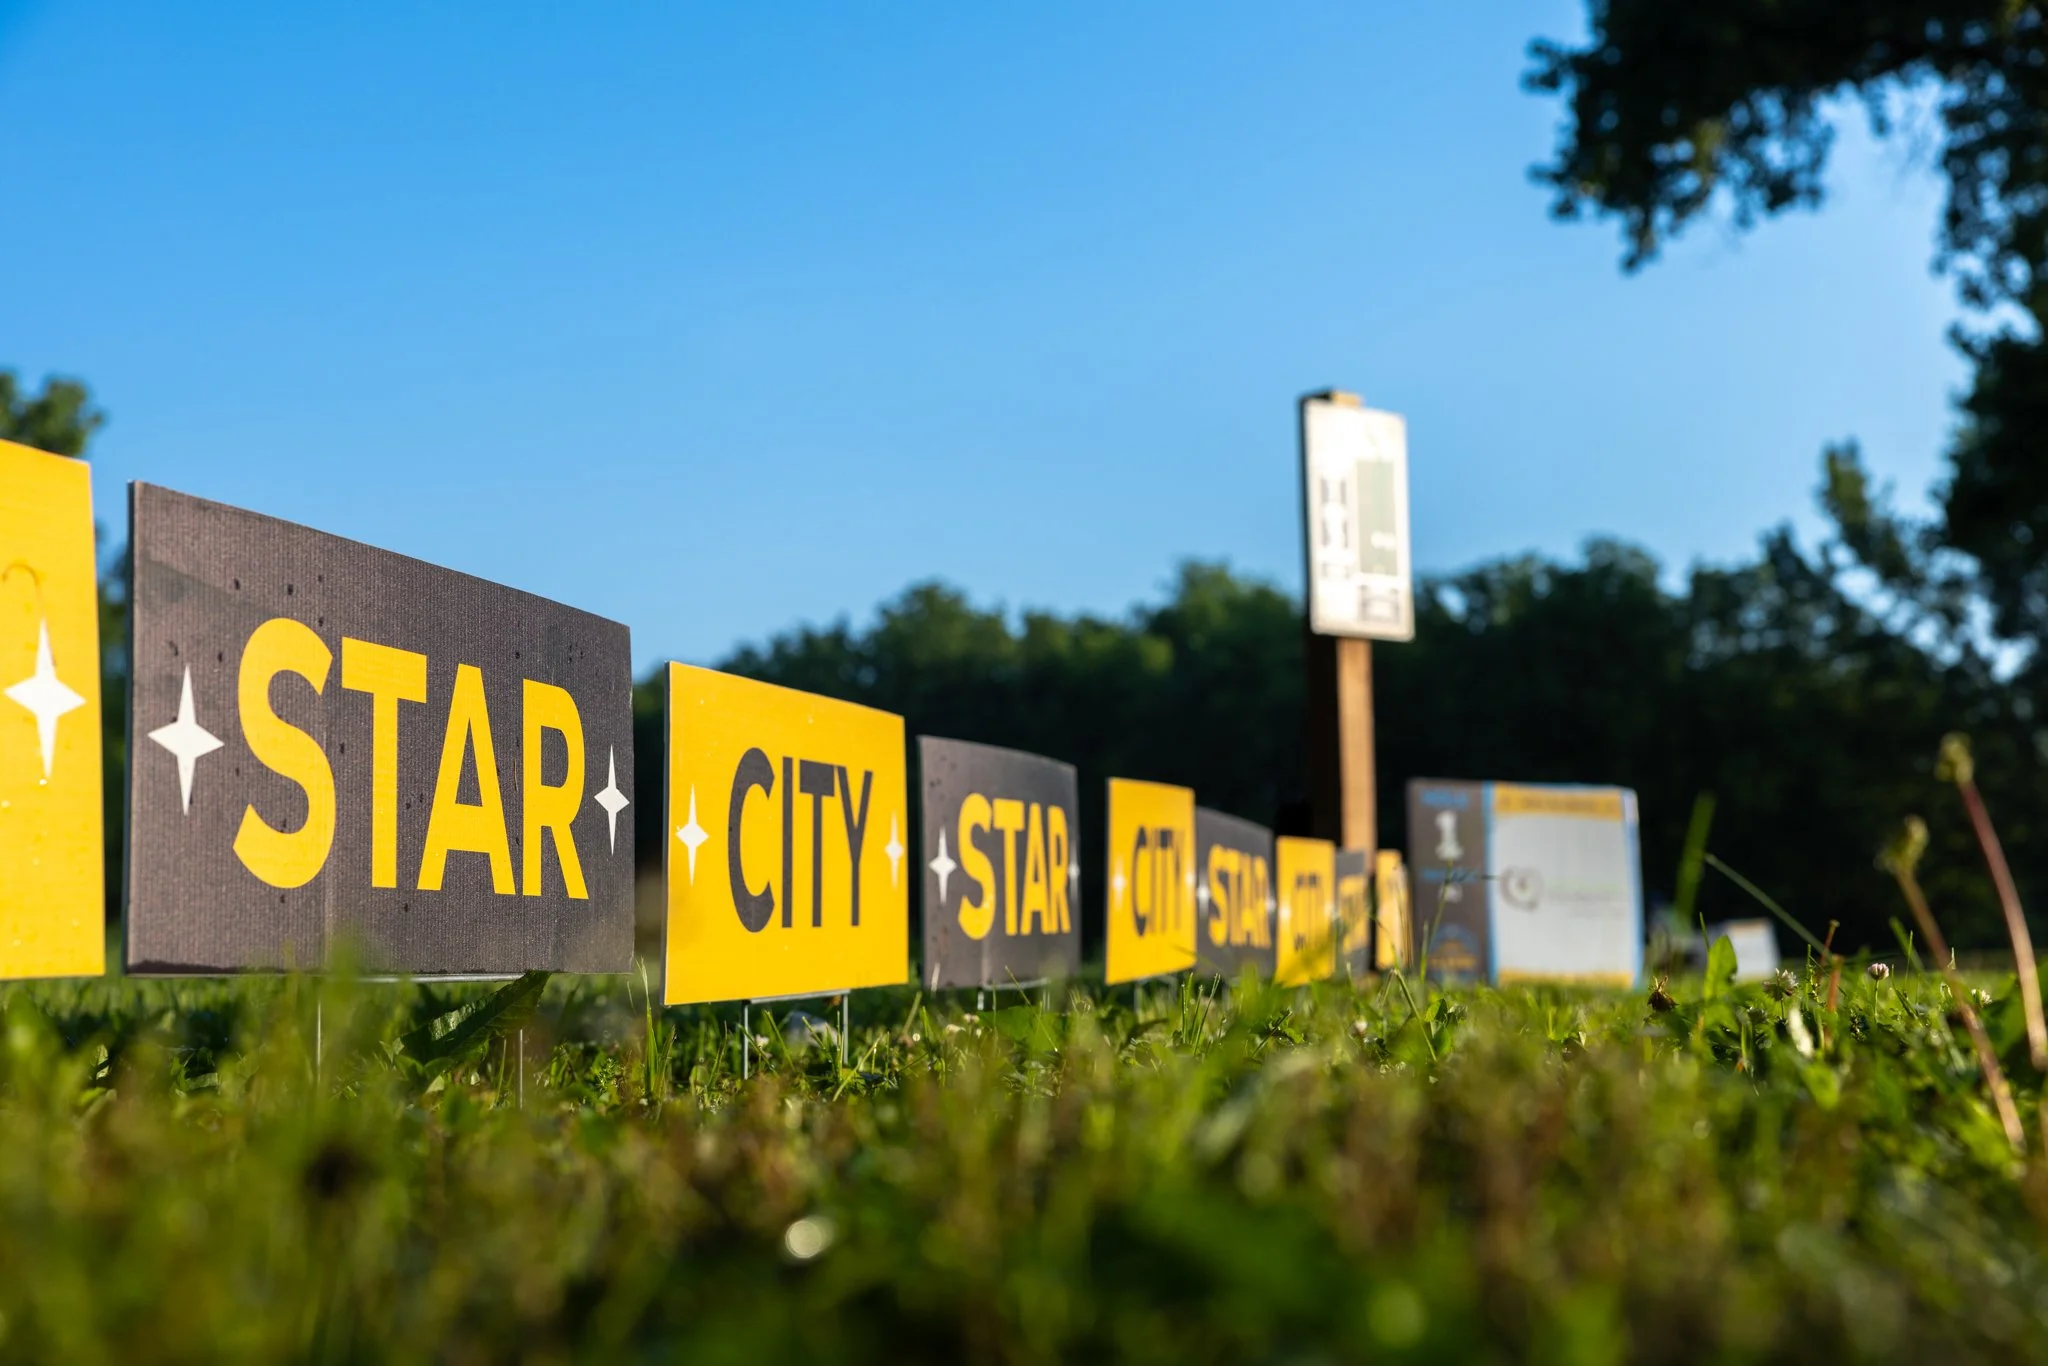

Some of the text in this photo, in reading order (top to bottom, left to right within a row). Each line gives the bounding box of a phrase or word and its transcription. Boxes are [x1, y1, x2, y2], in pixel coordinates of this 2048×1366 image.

[233, 617, 589, 899] STAR
[728, 747, 873, 933] CITY
[958, 793, 1071, 940] STAR
[1208, 843, 1271, 948] STAR
